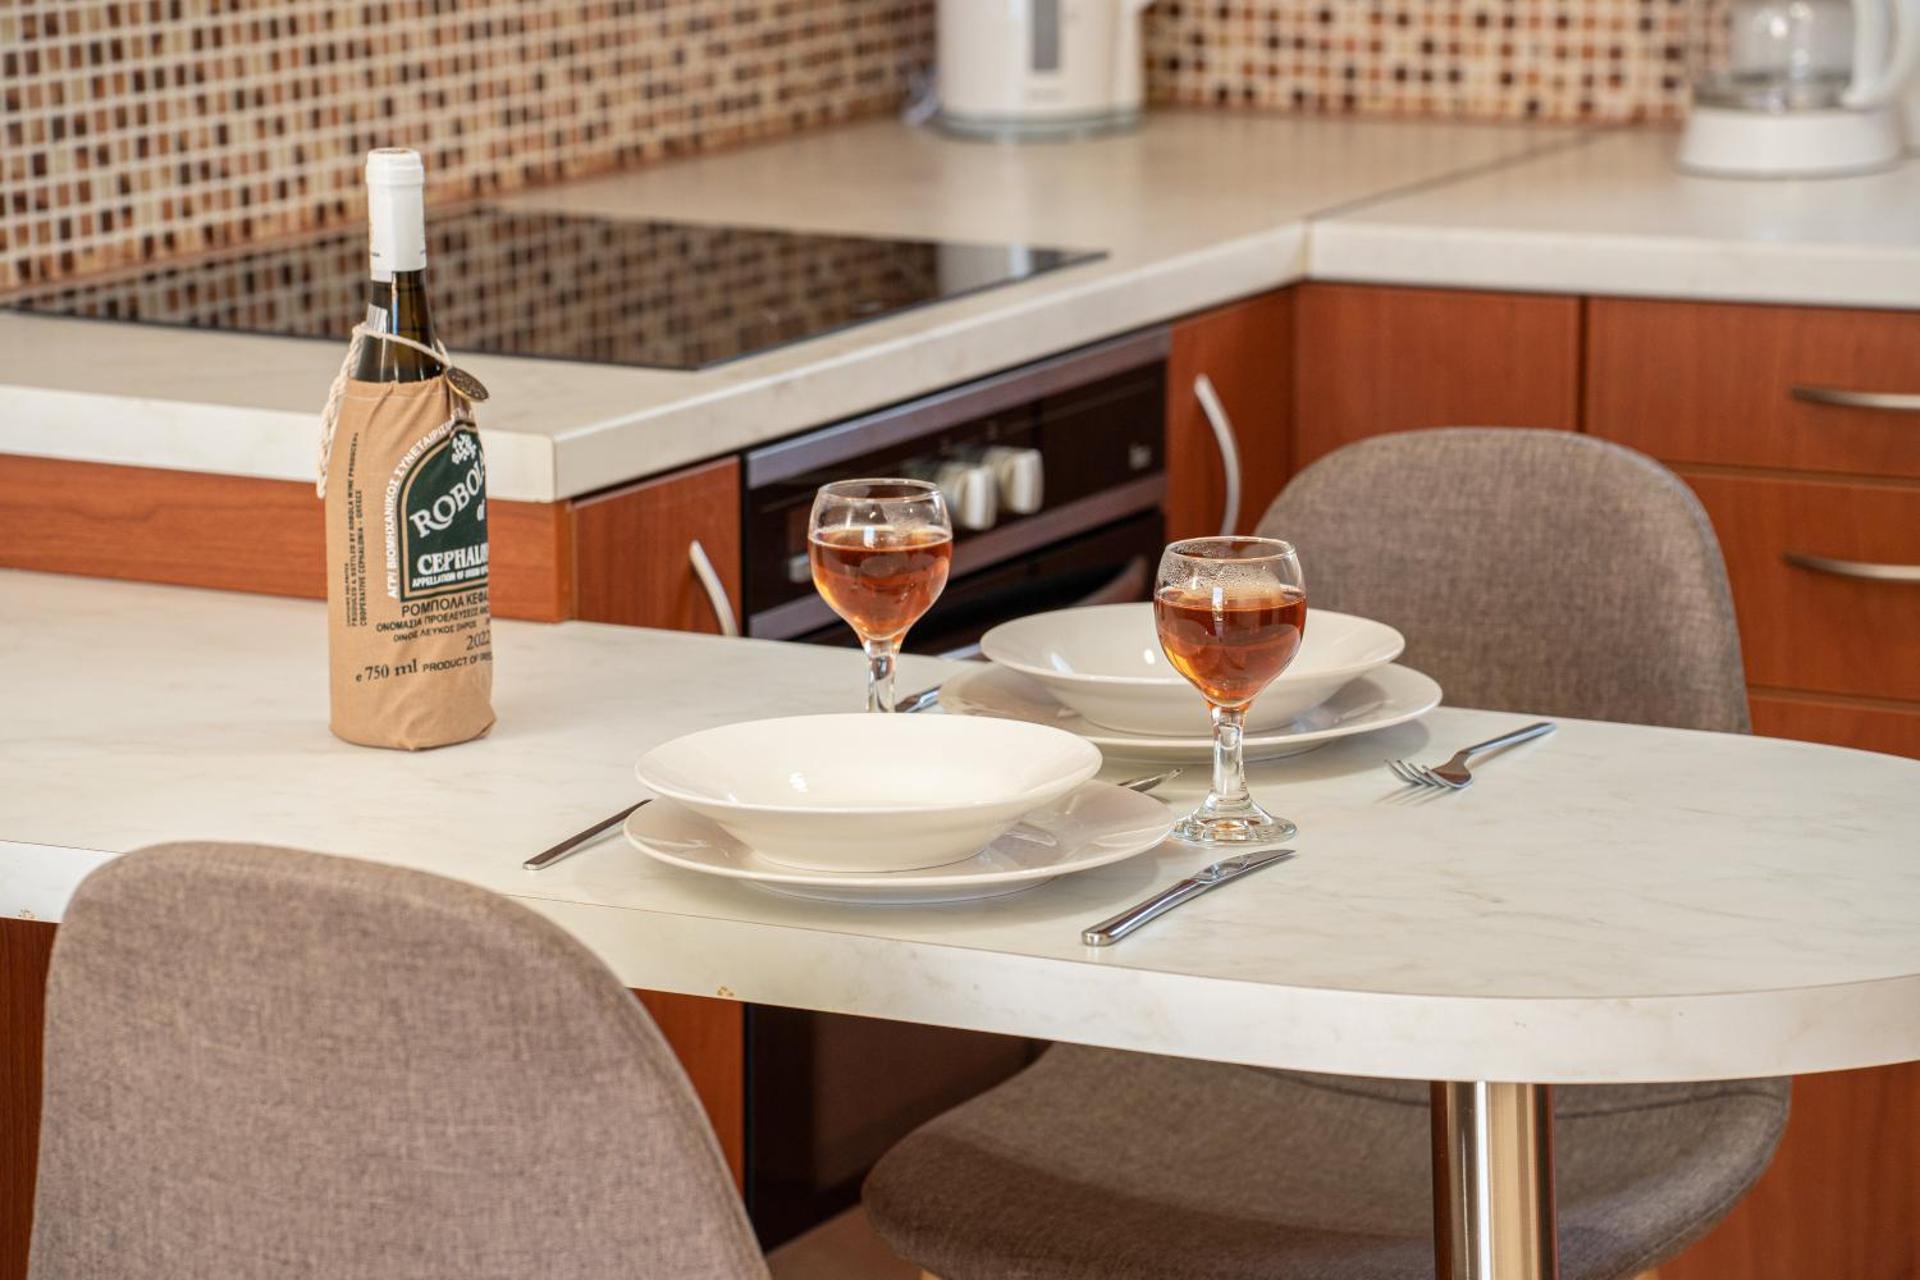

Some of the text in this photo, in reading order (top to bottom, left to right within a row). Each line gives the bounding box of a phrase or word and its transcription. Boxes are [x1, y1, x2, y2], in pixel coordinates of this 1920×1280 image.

[365, 664, 389, 680] 750
[395, 659, 417, 676] ml
[422, 656, 468, 673] PRODUCT
